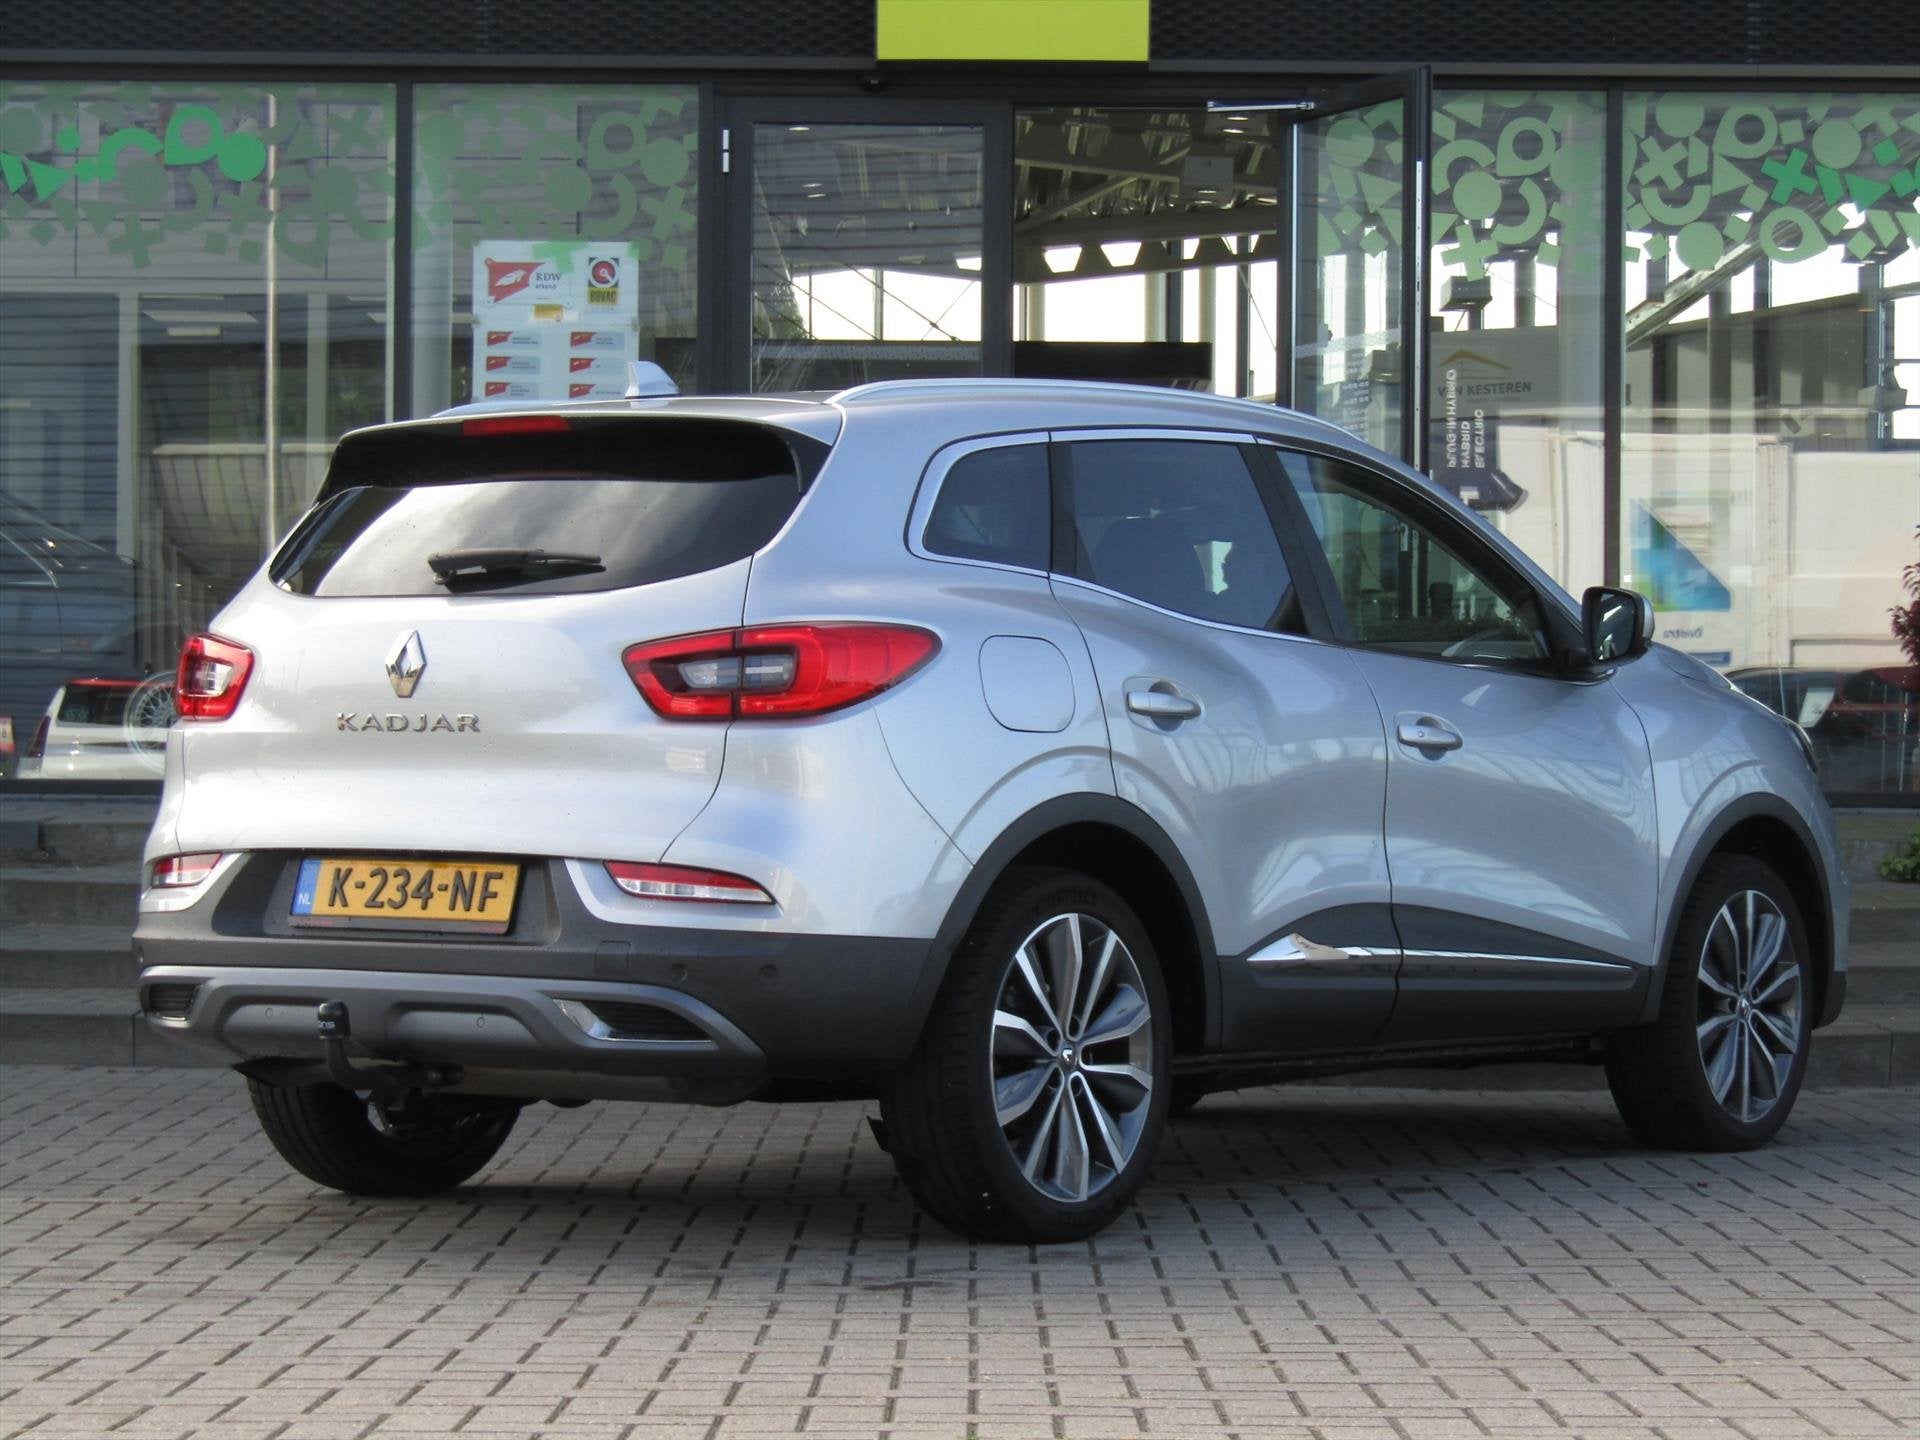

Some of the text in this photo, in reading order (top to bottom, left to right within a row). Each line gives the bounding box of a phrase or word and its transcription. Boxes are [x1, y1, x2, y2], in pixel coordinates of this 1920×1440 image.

[536, 272, 561, 281] RDW
[1467, 381, 1531, 396] KESTEREN
[337, 712, 481, 733] KADJAR
[328, 866, 504, 912] K-234-NF
[298, 893, 311, 905] NL
